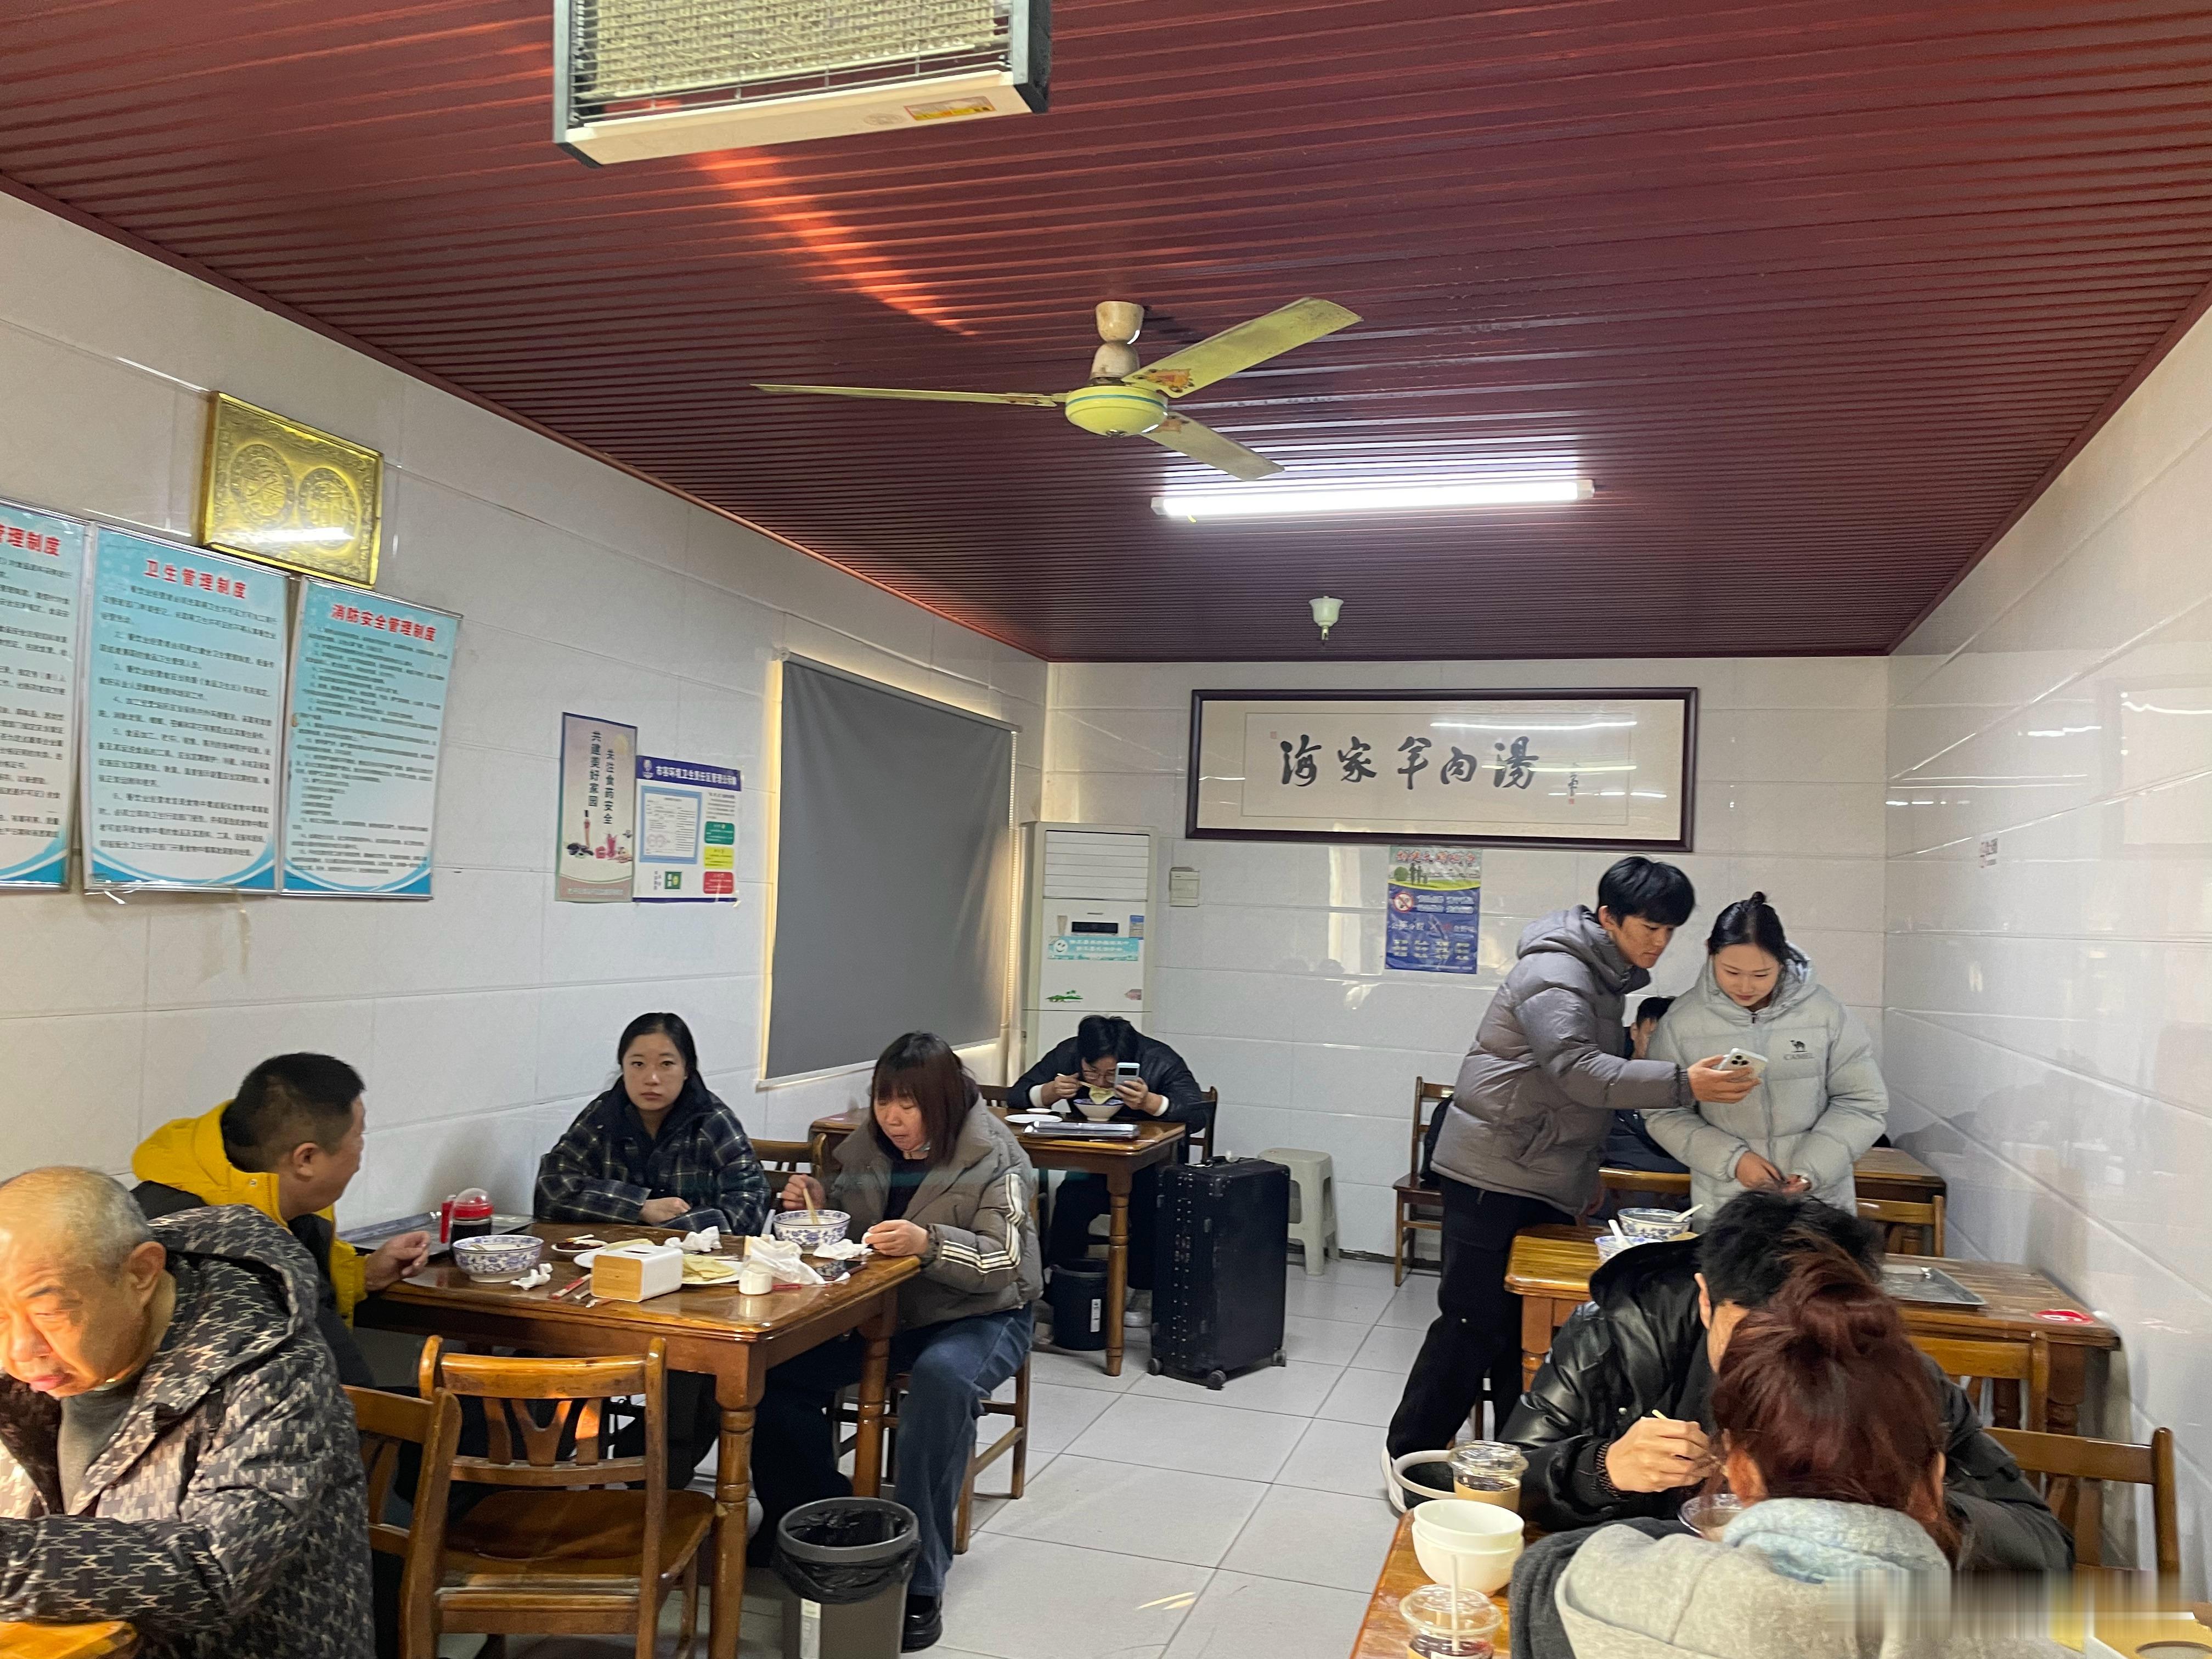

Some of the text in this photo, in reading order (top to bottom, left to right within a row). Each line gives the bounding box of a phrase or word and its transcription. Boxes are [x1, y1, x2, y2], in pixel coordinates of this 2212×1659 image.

[144, 559, 246, 599] 卫生管理制度
[331, 604, 437, 642] 消防安全管理制度
